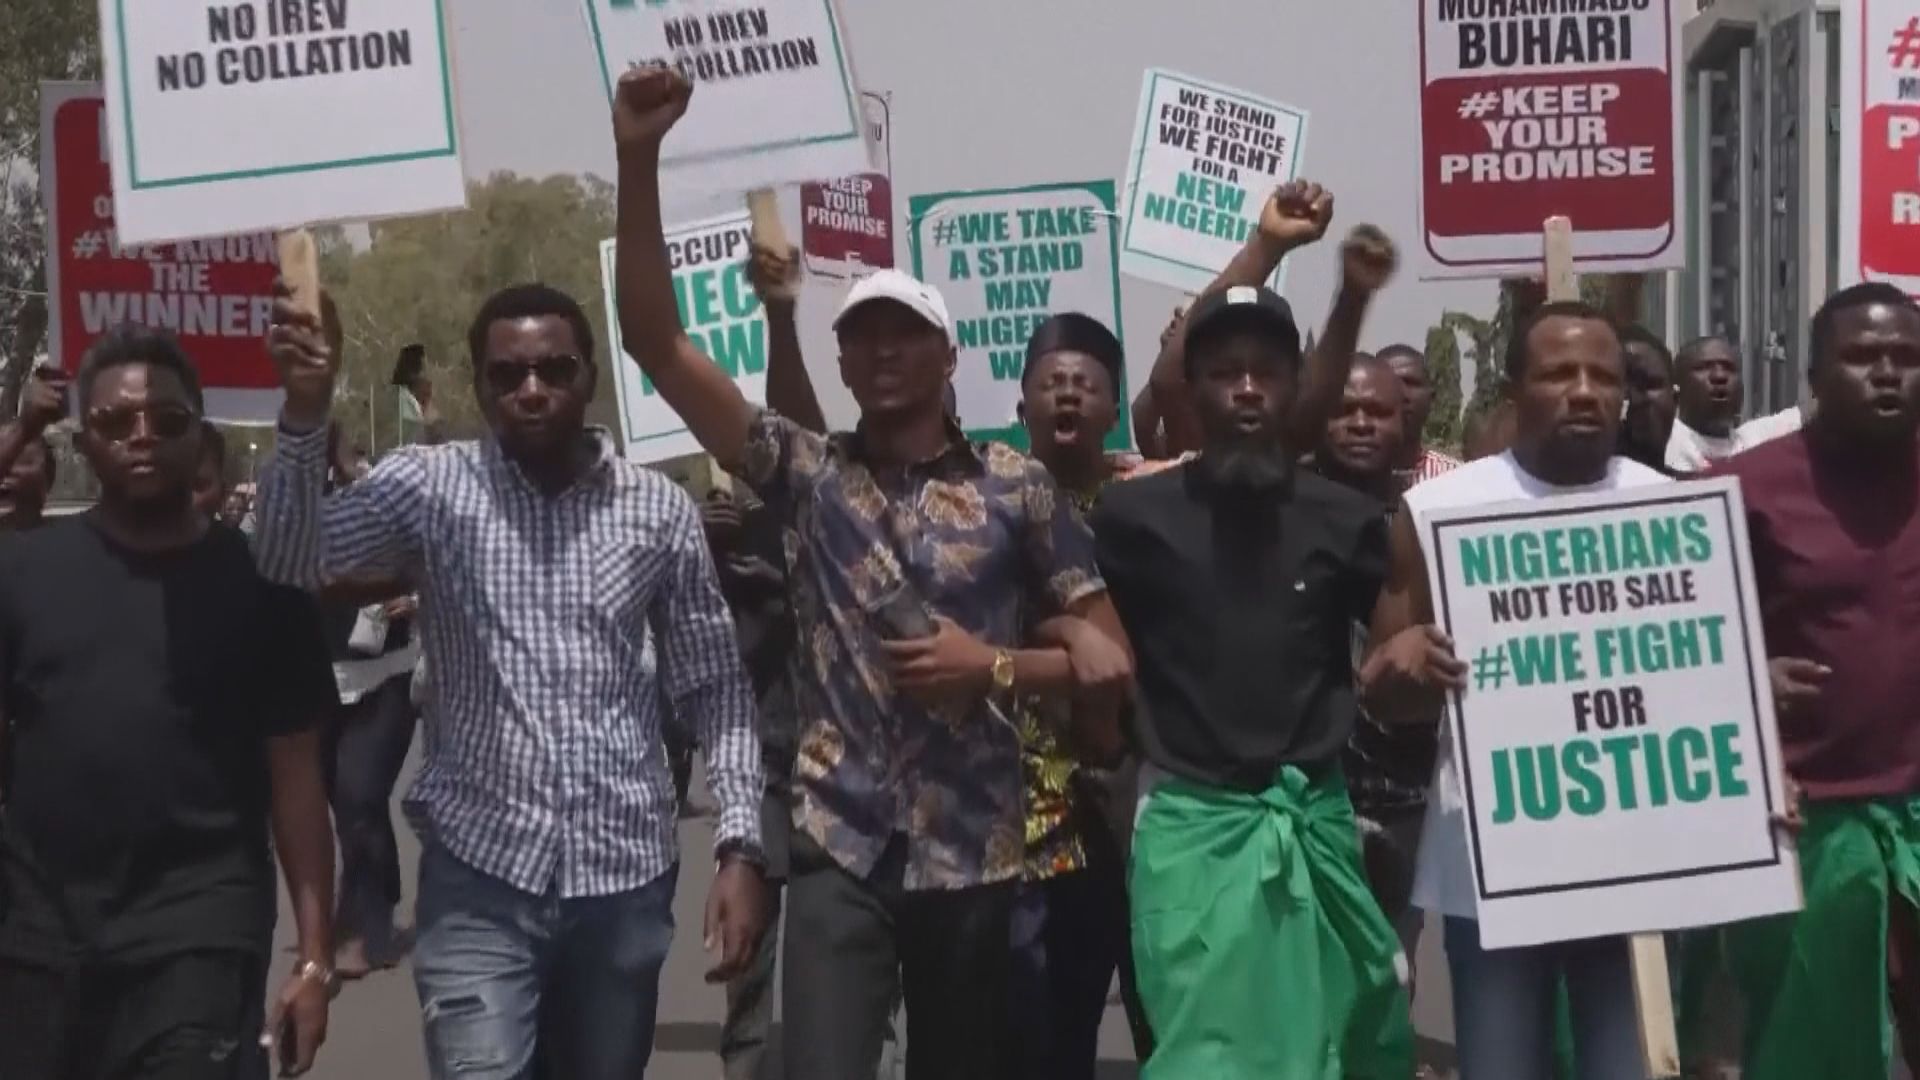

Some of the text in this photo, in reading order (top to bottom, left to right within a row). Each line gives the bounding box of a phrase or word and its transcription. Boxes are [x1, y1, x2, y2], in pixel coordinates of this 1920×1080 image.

[209, 0, 348, 43] NO IREV
[664, 7, 769, 51] NO IREV
[1458, 15, 1632, 69] BUHARI
[157, 29, 412, 92] NO COLLATION
[1179, 87, 1277, 131] WE STAND
[1457, 83, 1620, 118] #KEEP
[1159, 122, 1282, 176] WE FIGHT
[1160, 103, 1287, 154] FOR JUSTICE
[1483, 116, 1608, 150] YOUR
[1191, 156, 1240, 184] FOR A
[1440, 146, 1656, 184] PROMISE
[822, 189, 869, 215] YOUR
[1175, 170, 1247, 214] NEW
[807, 205, 888, 239] PROMISE
[933, 206, 1098, 247] #WE TAKE
[1143, 192, 1258, 243] NIGERI
[663, 227, 752, 269] CCUPY
[949, 241, 1084, 280] A STAND
[150, 261, 212, 293] THE
[984, 277, 1052, 312] MAY
[79, 291, 274, 338] WINNER
[1459, 513, 1713, 587] NIGERIANS
[1488, 569, 1698, 624] NOT FOR SALE
[1472, 615, 1726, 691] #WE FIGHT
[1571, 685, 1648, 733] FOR
[1489, 722, 1749, 825] JUSTICE
